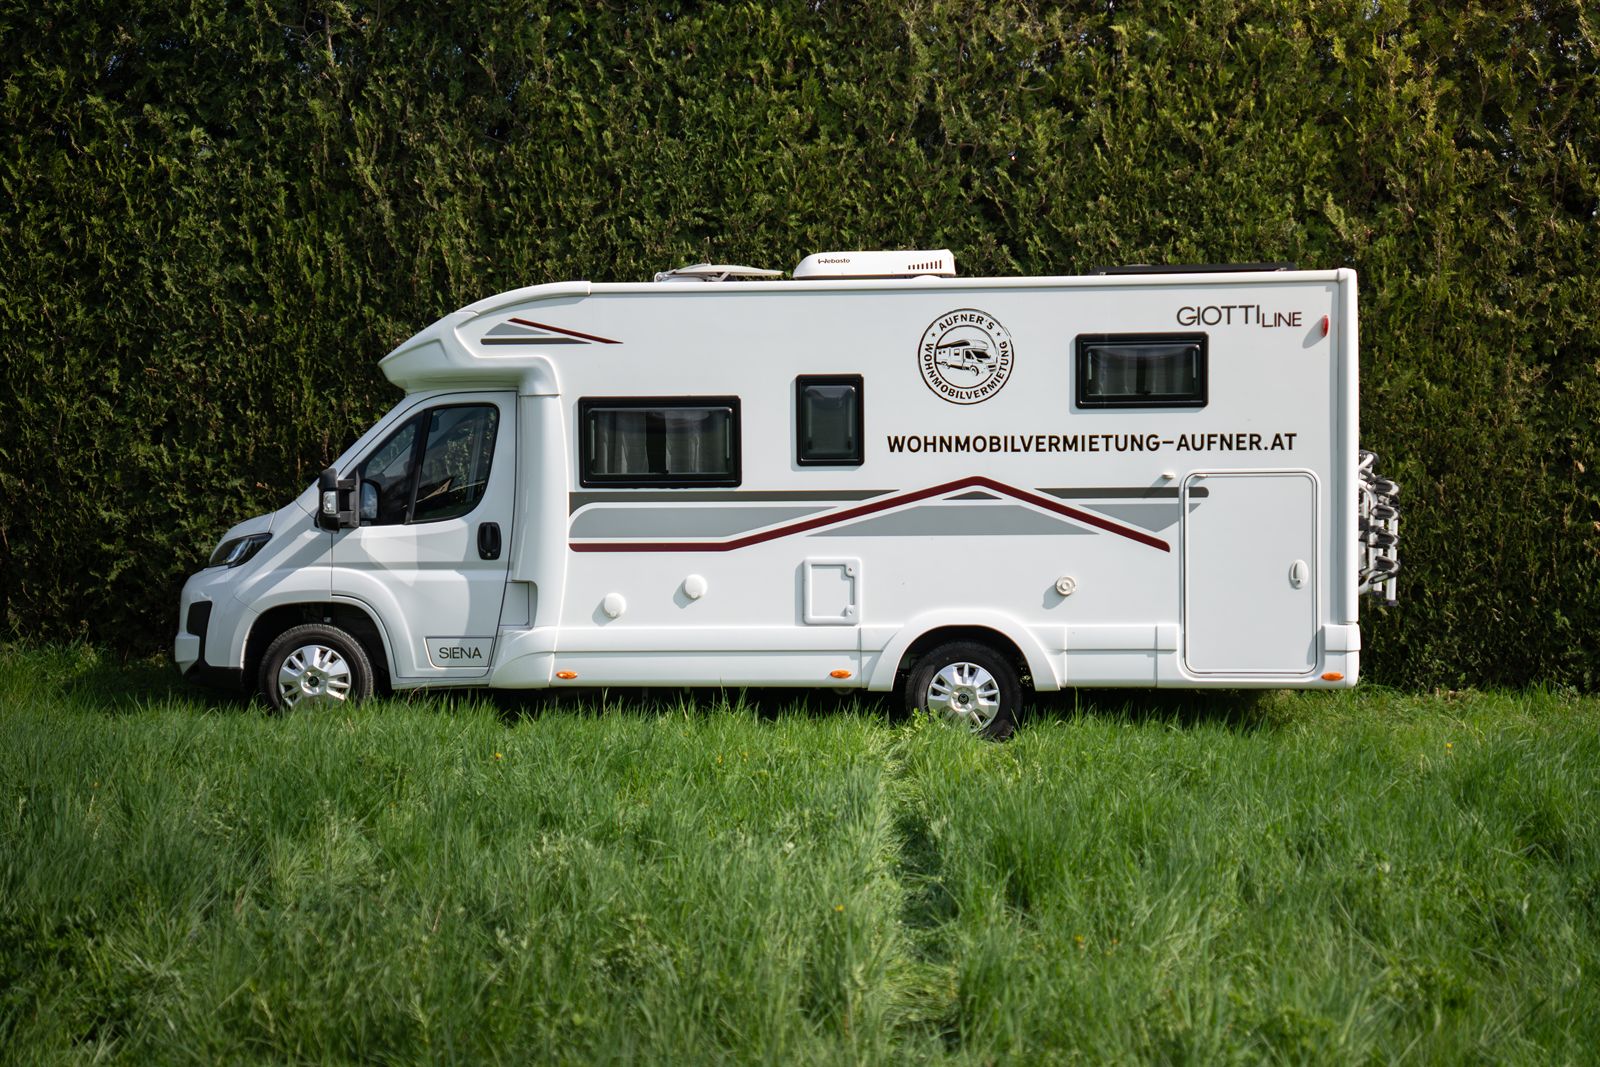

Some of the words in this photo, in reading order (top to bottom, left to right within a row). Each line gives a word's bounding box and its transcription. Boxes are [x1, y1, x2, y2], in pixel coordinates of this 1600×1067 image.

[938, 313, 995, 332] AUFNER'S
[923, 341, 1009, 400] WOHNMOBILVERMIETUNG
[887, 433, 1298, 453] WOHNMOBILVERMIETUNG-AUFNER.AT
[438, 646, 482, 659] SIENA
